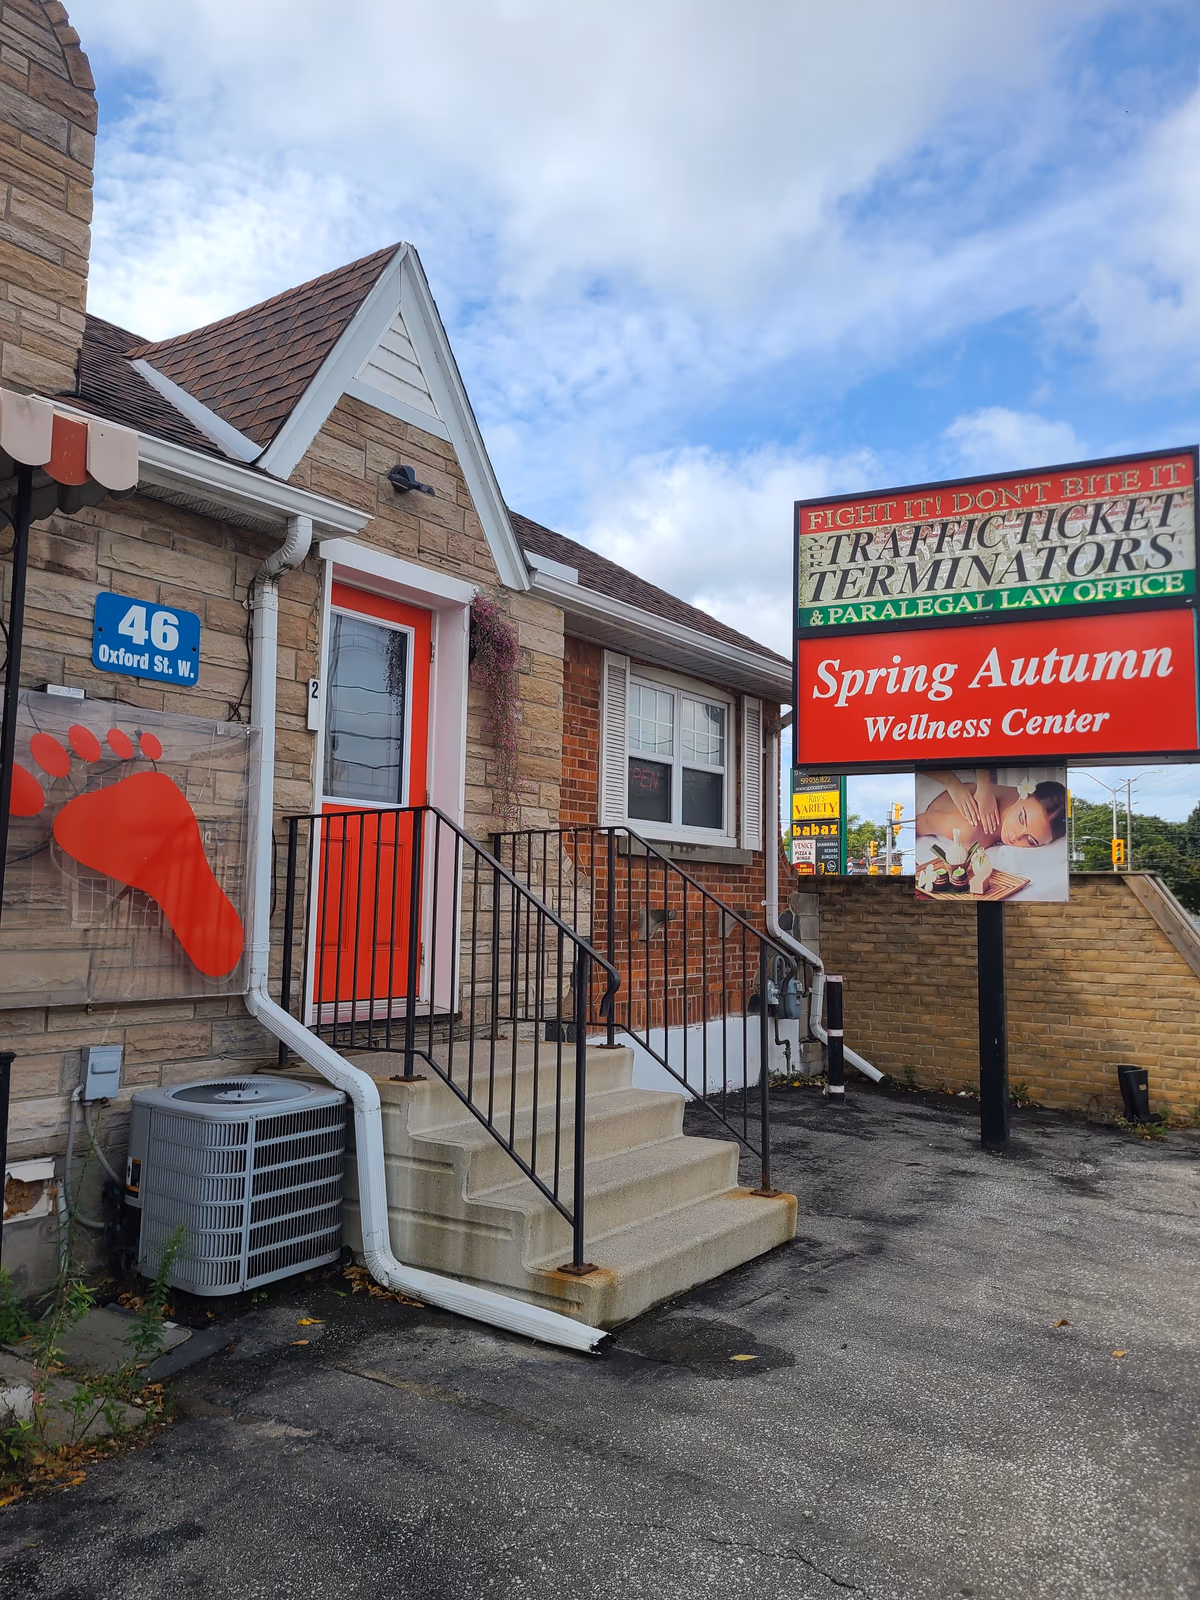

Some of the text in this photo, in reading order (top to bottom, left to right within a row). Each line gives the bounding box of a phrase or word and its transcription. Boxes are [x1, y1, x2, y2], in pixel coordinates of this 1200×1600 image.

[807, 462, 1186, 531] FIGHT IT! DON'T BITE IT
[826, 490, 1185, 566] TRAFFIC TICKET
[807, 536, 825, 568] YOUR
[808, 531, 1177, 603] TERMINATORS
[809, 572, 1186, 627] & PARALEGAL LAW OFFICE
[117, 604, 180, 651] 46
[99, 643, 195, 678] Oxford St. W.
[812, 646, 1174, 707] Spring Autumn
[311, 681, 319, 699] 2
[863, 707, 1111, 742] Wellness Center
[795, 802, 838, 815] VARIETY
[792, 823, 838, 837] babaz
